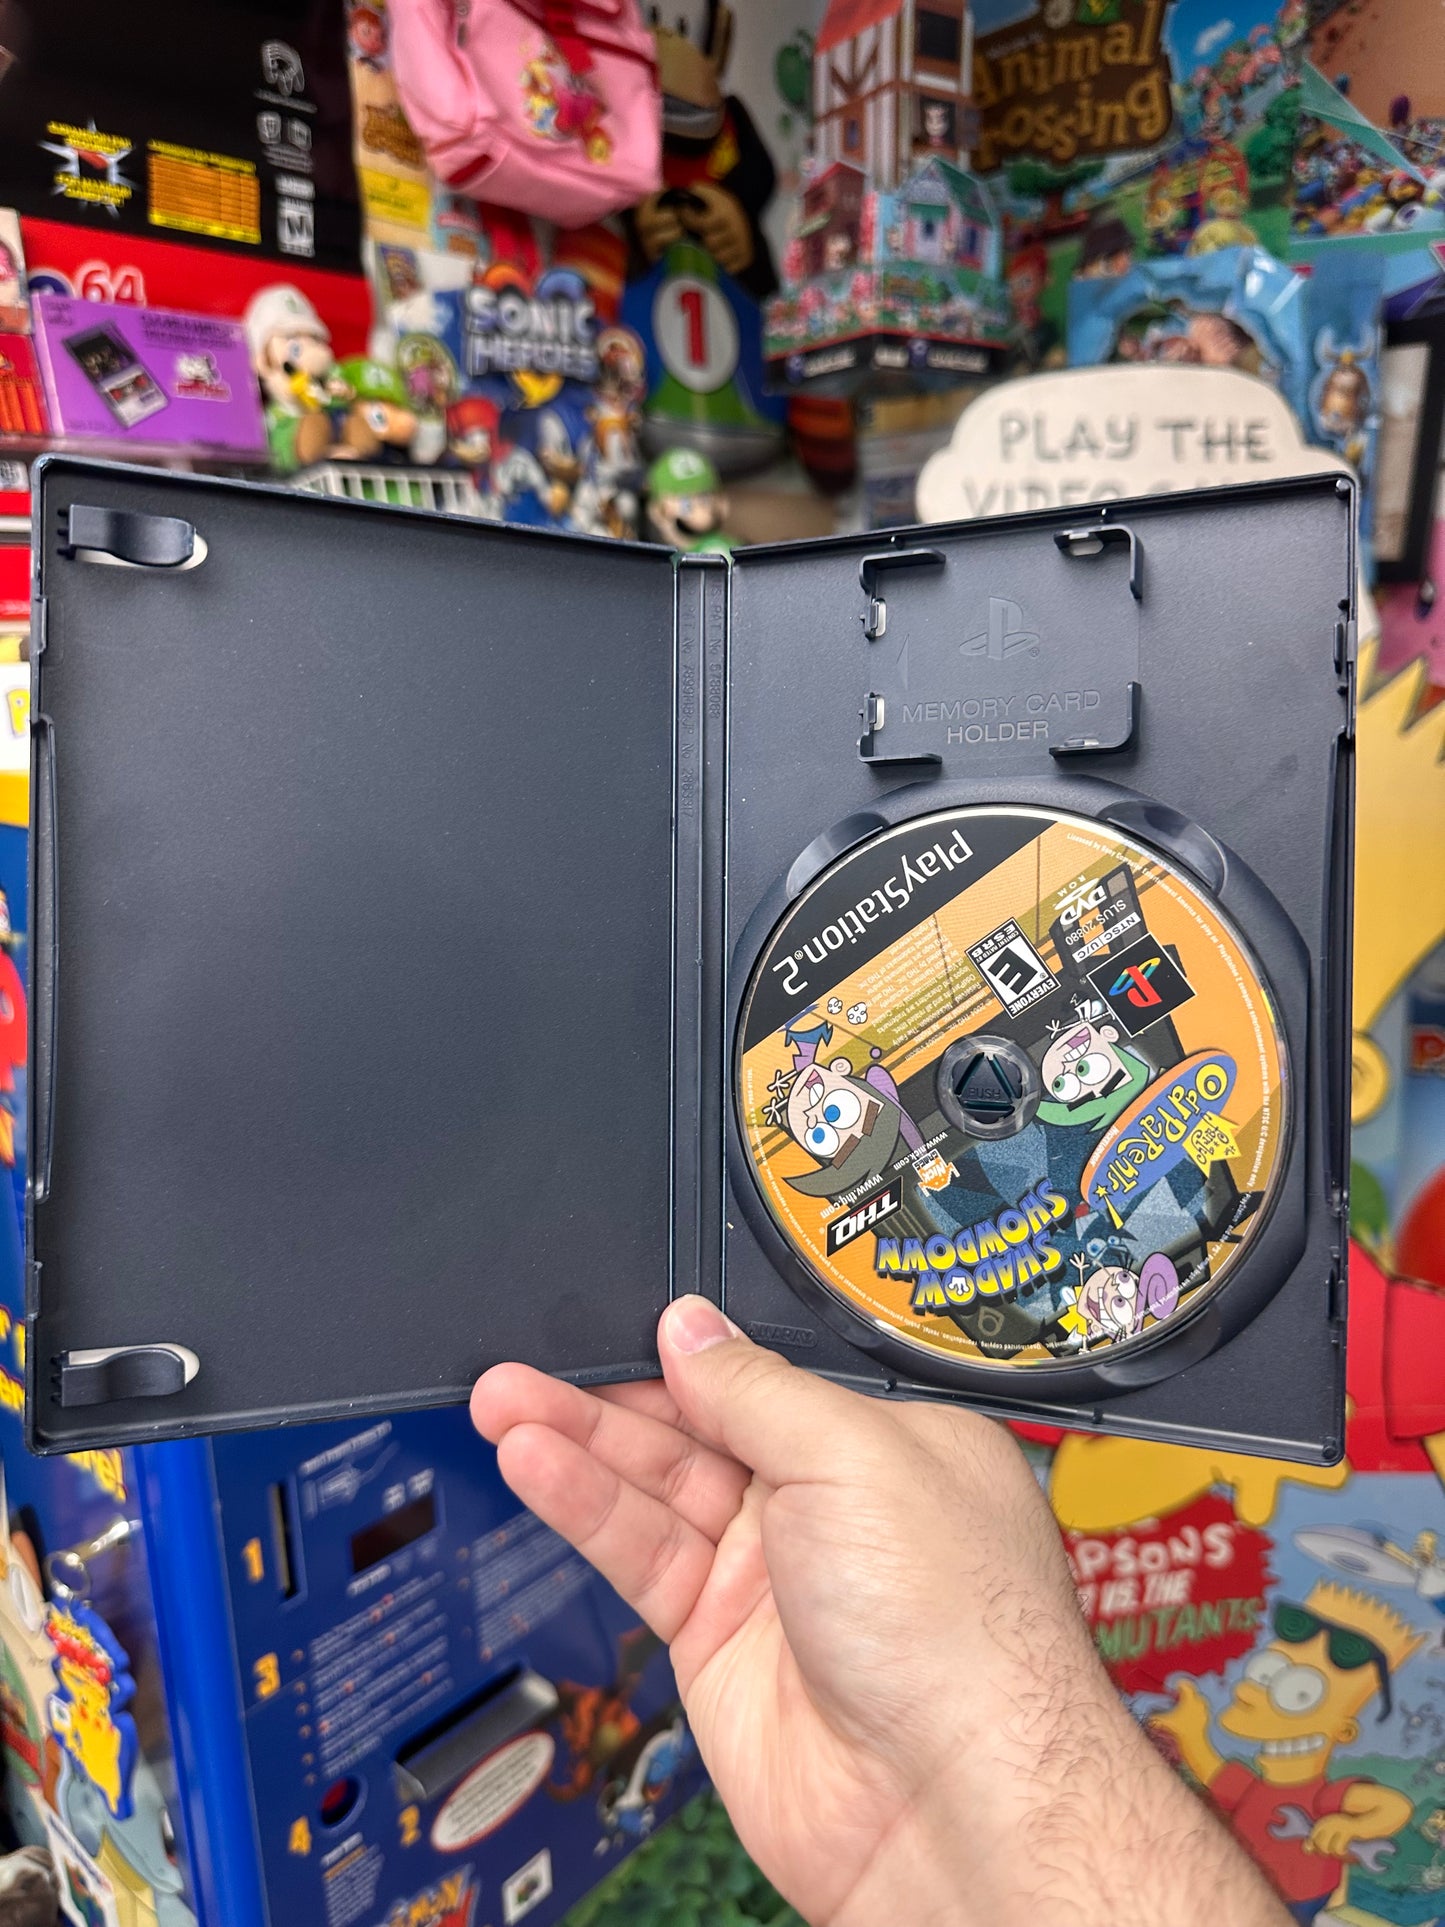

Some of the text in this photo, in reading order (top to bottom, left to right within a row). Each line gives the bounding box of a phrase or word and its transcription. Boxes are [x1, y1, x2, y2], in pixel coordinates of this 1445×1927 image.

[973, 70, 1168, 172] rossing
[74, 262, 147, 305] 64
[468, 286, 597, 340] SONIC
[677, 289, 709, 369] 1
[1001, 410, 1275, 463] PLAY THE
[902, 690, 1102, 724] MEMORY CARD
[946, 720, 1050, 745] HOLDER
[1057, 874, 1085, 896] ROM
[1059, 886, 1106, 925] DVD
[971, 924, 1015, 957] ESRB
[997, 930, 1018, 947] CONTENT
[1065, 899, 1126, 945] SLUS 20880
[1077, 916, 1135, 958] NTSC U/C
[982, 945, 998, 958] RATED
[987, 947, 1037, 995] E
[1008, 978, 1055, 1013] EVERYONE
[968, 1087, 1001, 1099] PUSH
[893, 1132, 947, 1170] www.nick.com
[820, 1173, 882, 1218] www.thq.com
[831, 1194, 897, 1244] THQ
[876, 1178, 1068, 1272] SHOWDOWN
[913, 1229, 1060, 1307] SHADOW
[242, 1536, 265, 1583] 1
[1070, 1523, 1236, 1582] PSONS
[1144, 1568, 1196, 1606] THE
[1096, 1597, 1264, 1663] MUTANTS
[253, 1652, 281, 1700] 3
[288, 1816, 312, 1856] 4
[398, 1806, 420, 1847] 2
